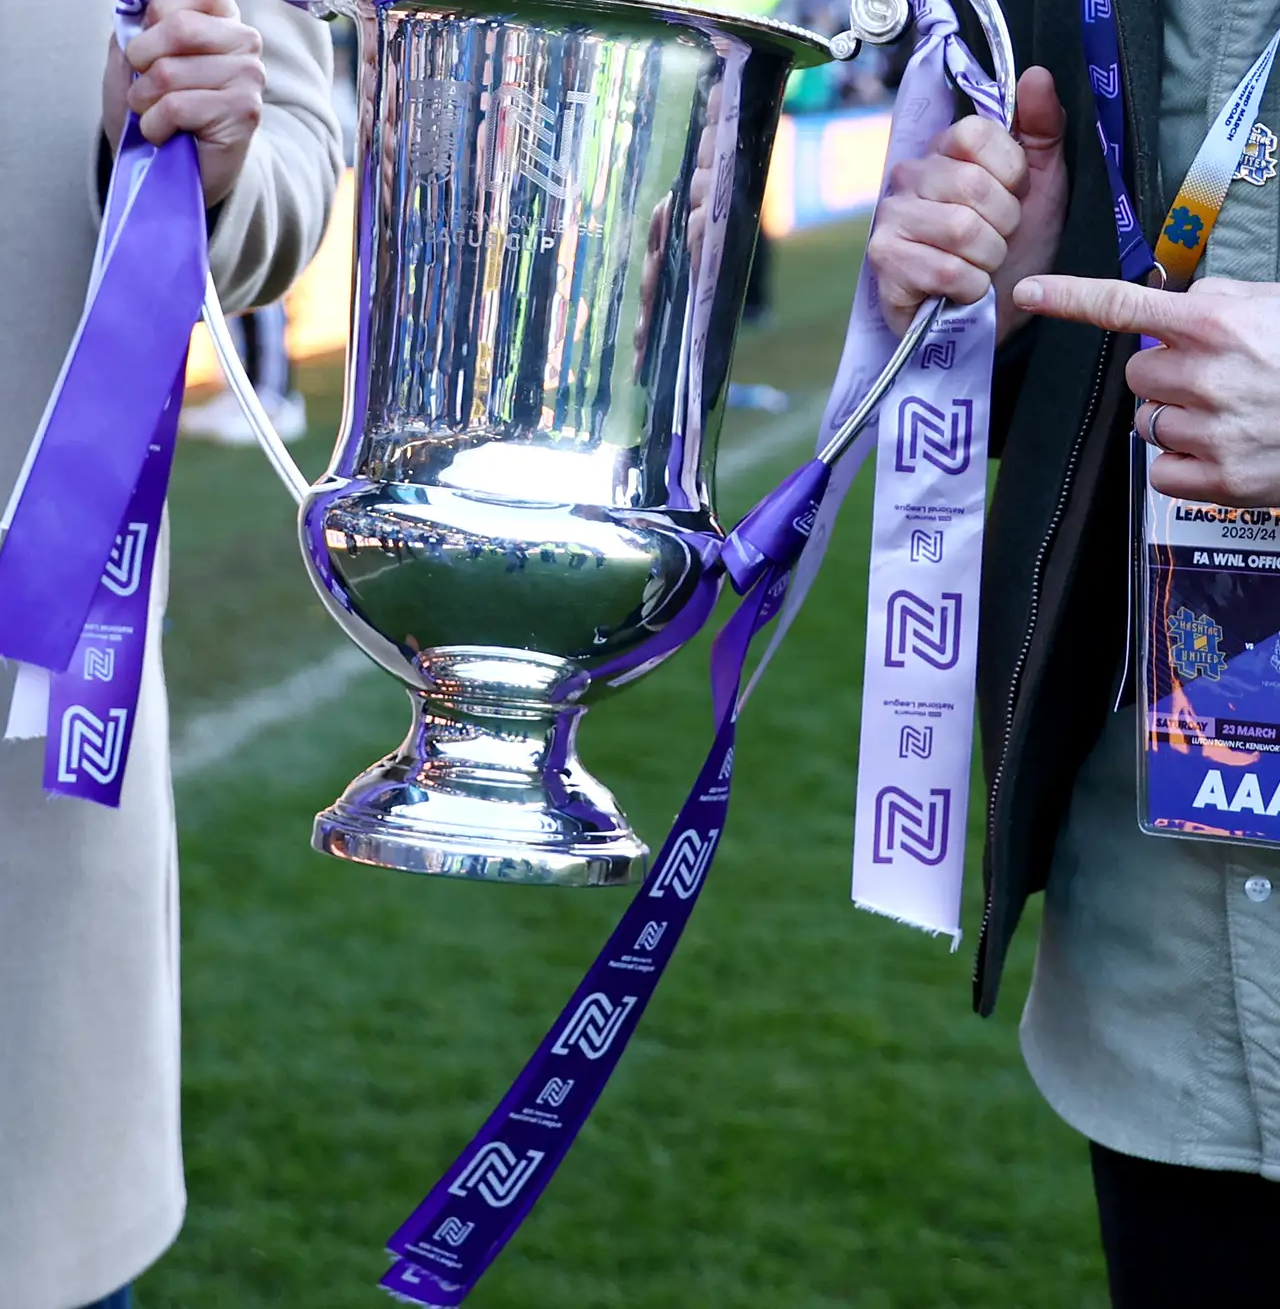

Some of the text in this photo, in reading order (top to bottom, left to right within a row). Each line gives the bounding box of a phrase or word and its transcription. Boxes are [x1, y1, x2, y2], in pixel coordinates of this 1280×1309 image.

[1225, 102, 1240, 127] ROAD
[1227, 108, 1246, 141] MARCH
[894, 503, 965, 514] National League
[1175, 506, 1237, 524] LEAGUE
[1240, 510, 1271, 527] CUP
[1221, 526, 1277, 541] 2023/24
[1192, 551, 1210, 565] FA
[1213, 552, 1244, 568] WNL
[1179, 620, 1219, 636] HASHTAG
[1182, 649, 1219, 664] UNITED
[883, 697, 955, 711] National League
[1156, 717, 1208, 732] SATURDAY
[1222, 724, 1276, 739] 23 MARCH
[1191, 737, 1214, 745] LUTON
[1214, 739, 1235, 748] TOWN
